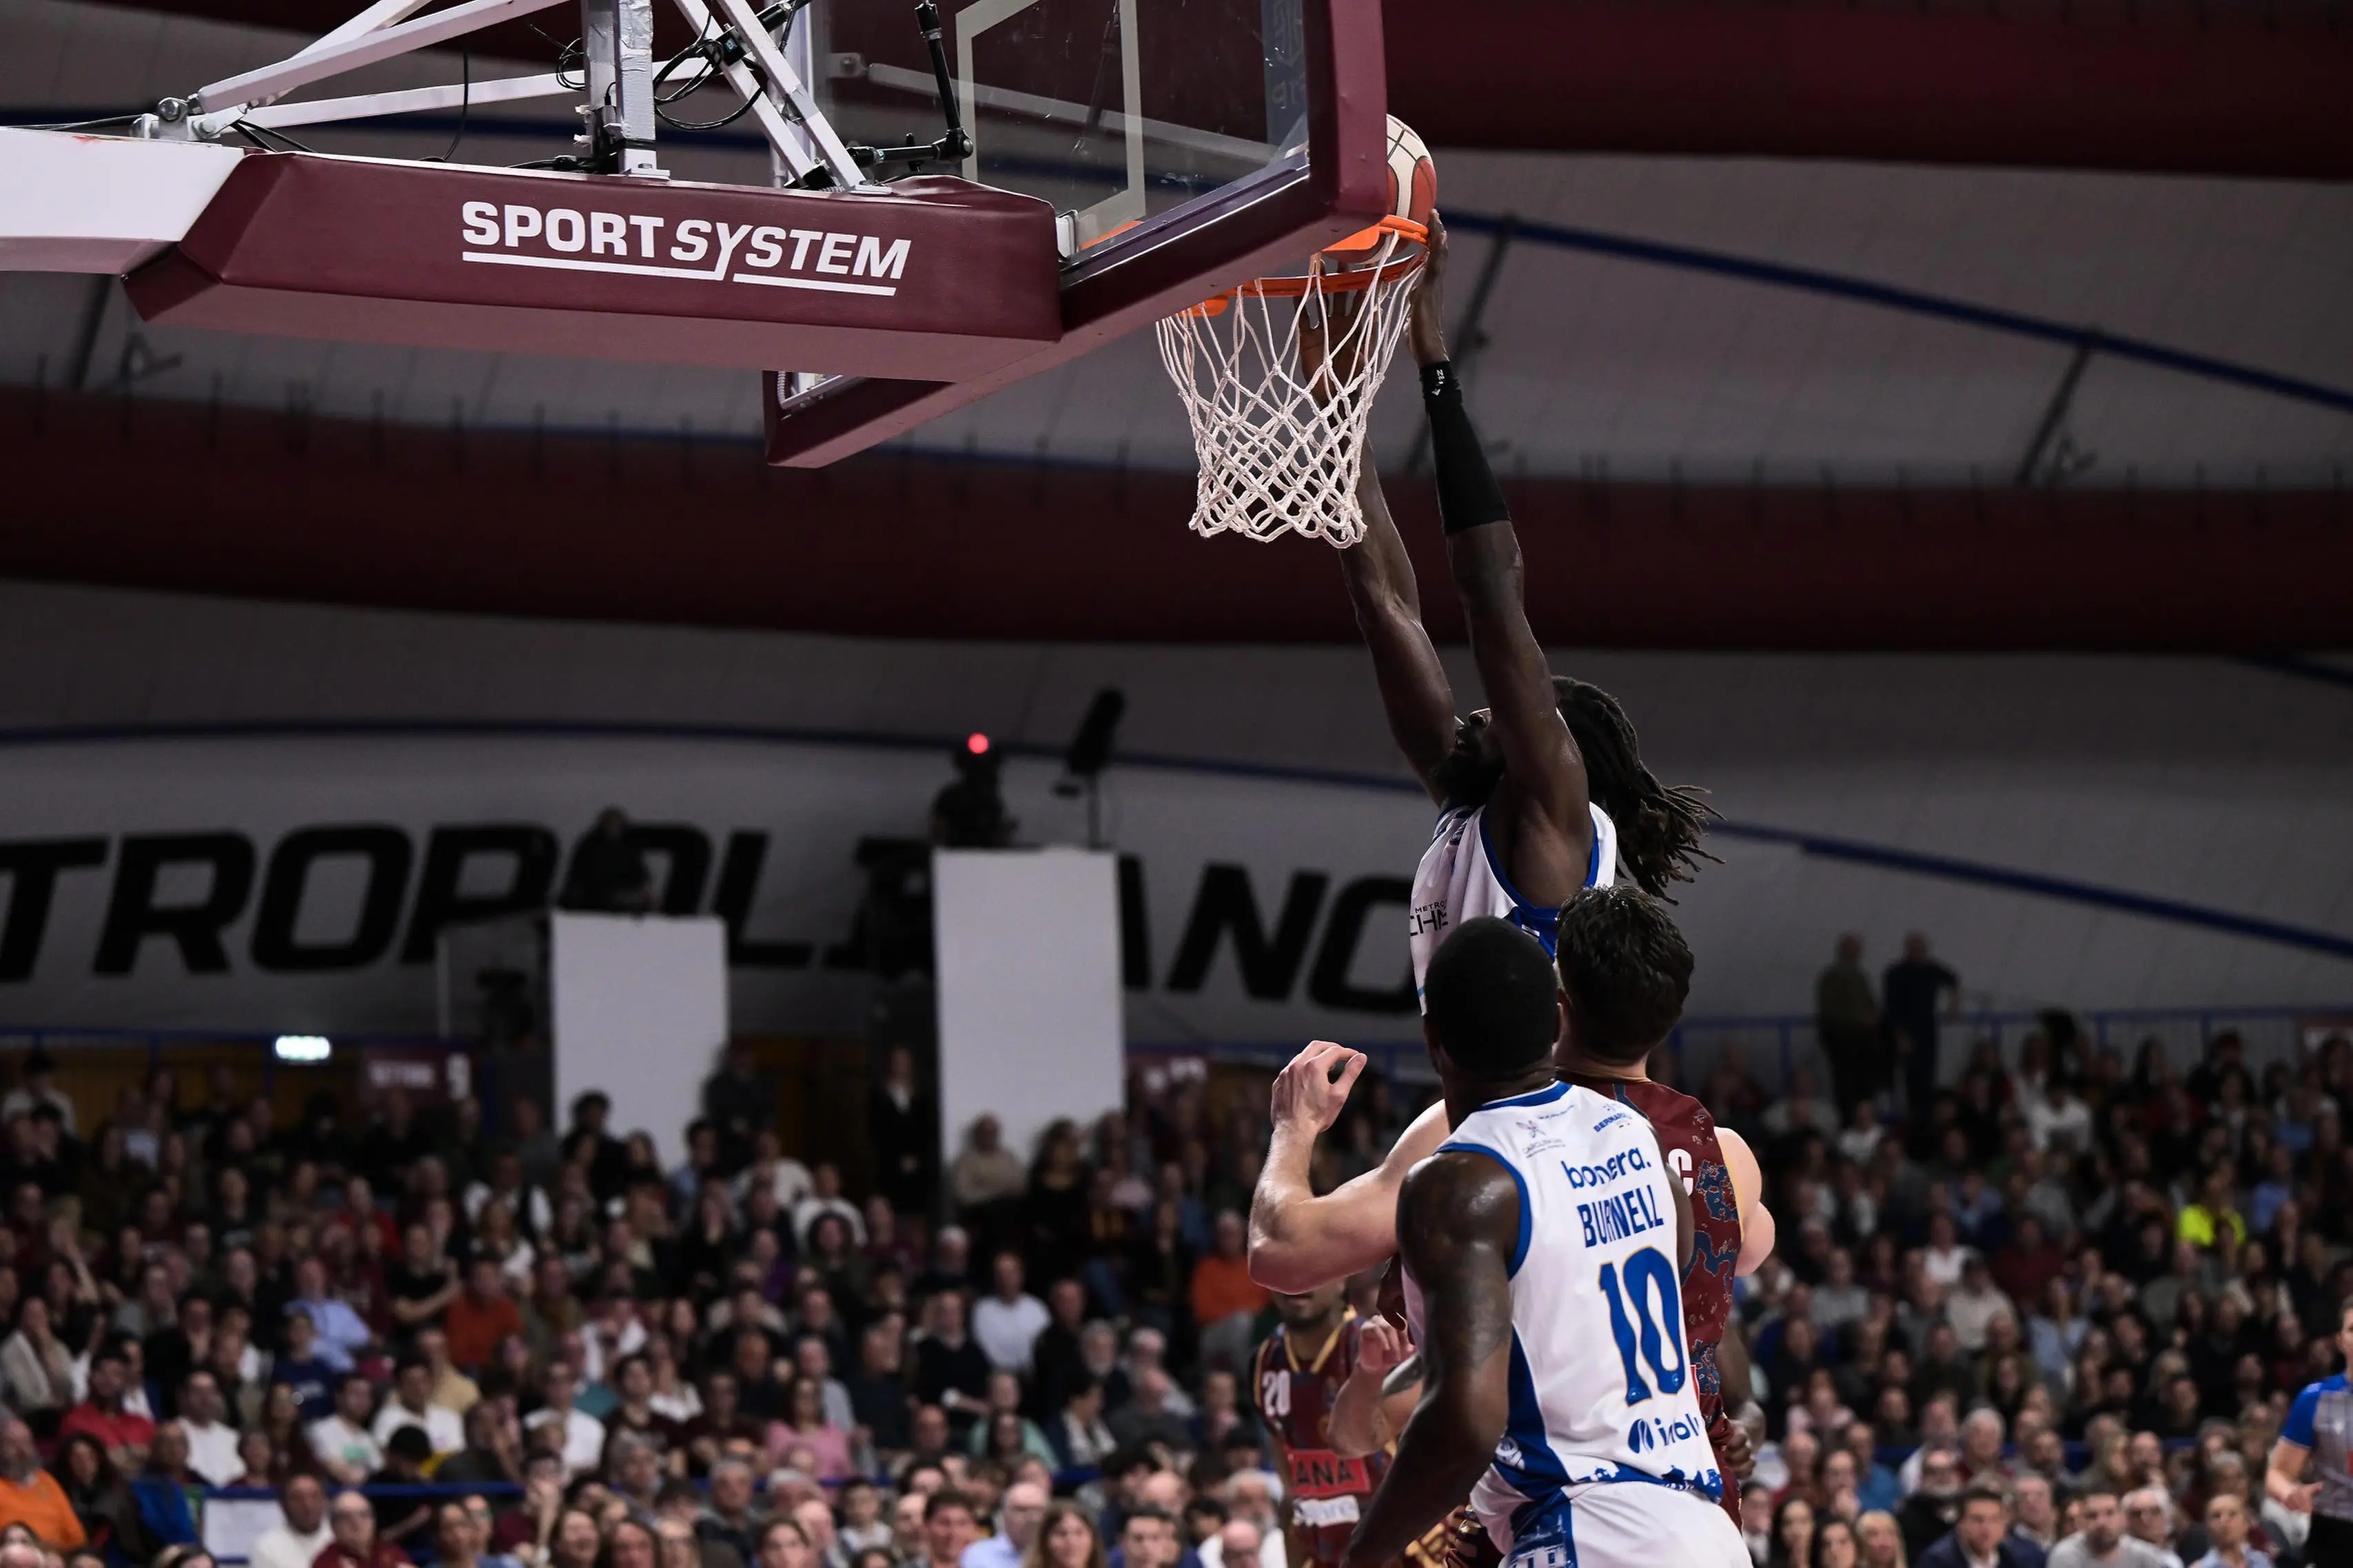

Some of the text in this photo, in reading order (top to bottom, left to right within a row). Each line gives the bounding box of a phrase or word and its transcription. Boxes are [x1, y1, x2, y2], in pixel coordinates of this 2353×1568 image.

[462, 201, 912, 281] SPORT SYSTEM
[1576, 1184, 1664, 1249] BURNELL
[1598, 1245, 1686, 1407] 10
[1261, 1368, 1292, 1418] 20
